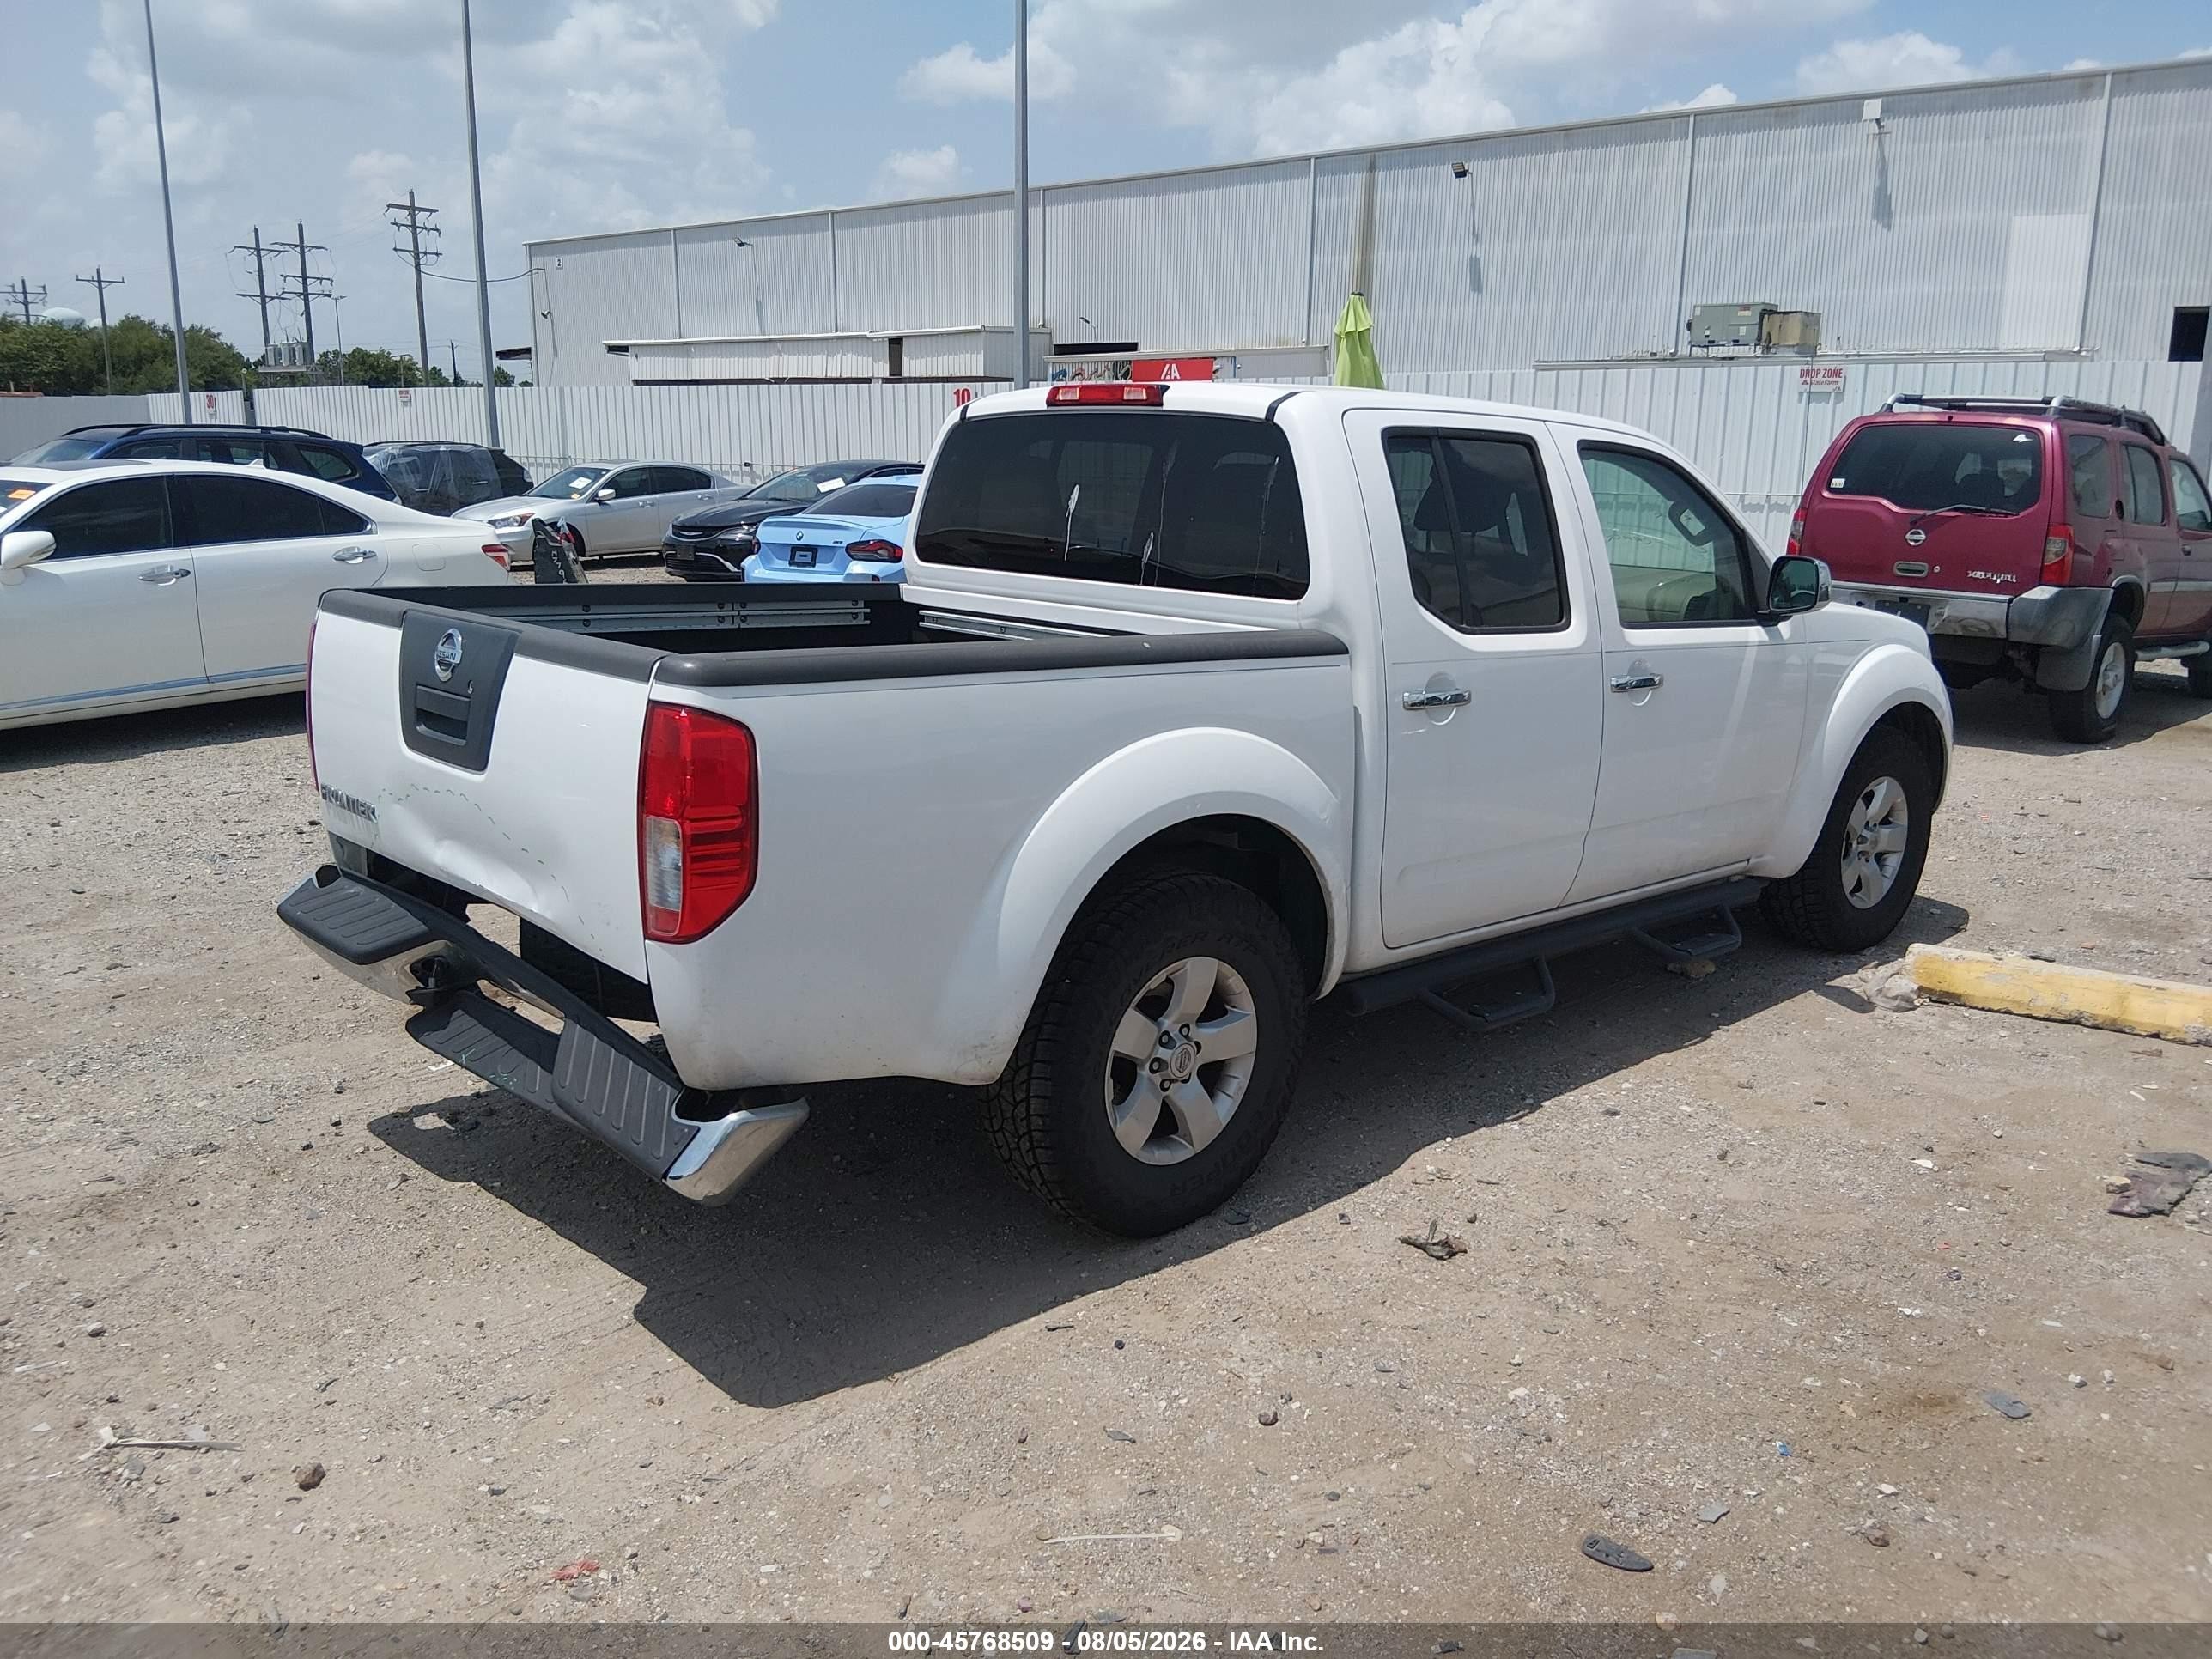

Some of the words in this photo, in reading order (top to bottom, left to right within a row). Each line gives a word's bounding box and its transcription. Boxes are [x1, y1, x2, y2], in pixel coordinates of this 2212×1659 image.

[1800, 368, 1820, 379] DROP
[1822, 368, 1843, 379] ZONE
[953, 388, 971, 408] 10
